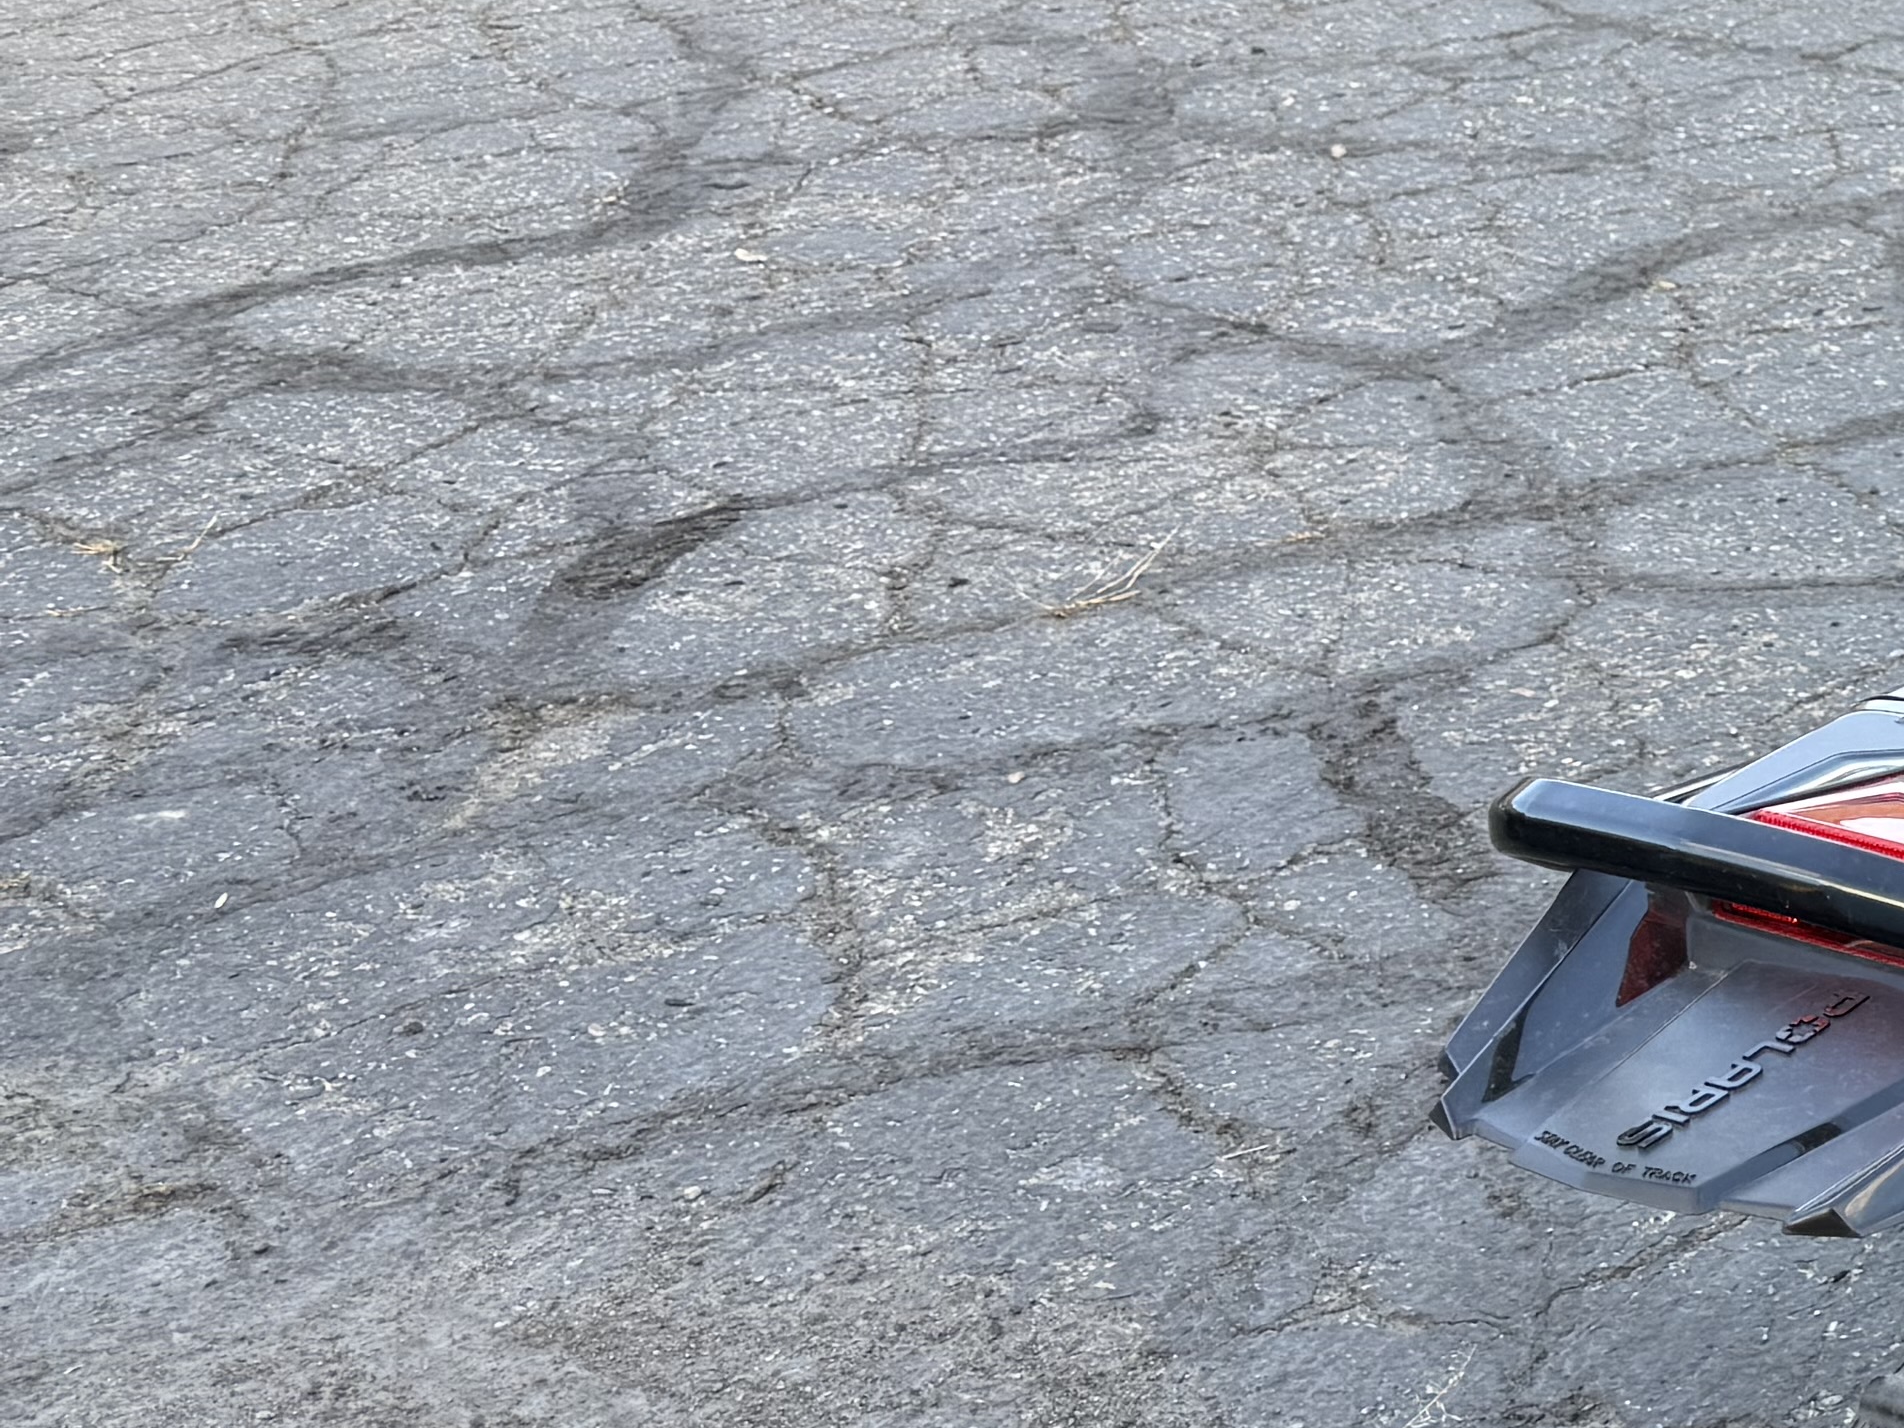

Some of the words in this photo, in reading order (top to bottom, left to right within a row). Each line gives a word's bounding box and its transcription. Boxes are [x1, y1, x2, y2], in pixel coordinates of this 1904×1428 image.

[1616, 989, 1871, 1150] POLARIS
[1534, 1129, 1570, 1157] STAY
[1562, 1144, 1606, 1170] CLEAR
[1611, 1161, 1637, 1177] OF
[1642, 1165, 1698, 1186] TRACK
